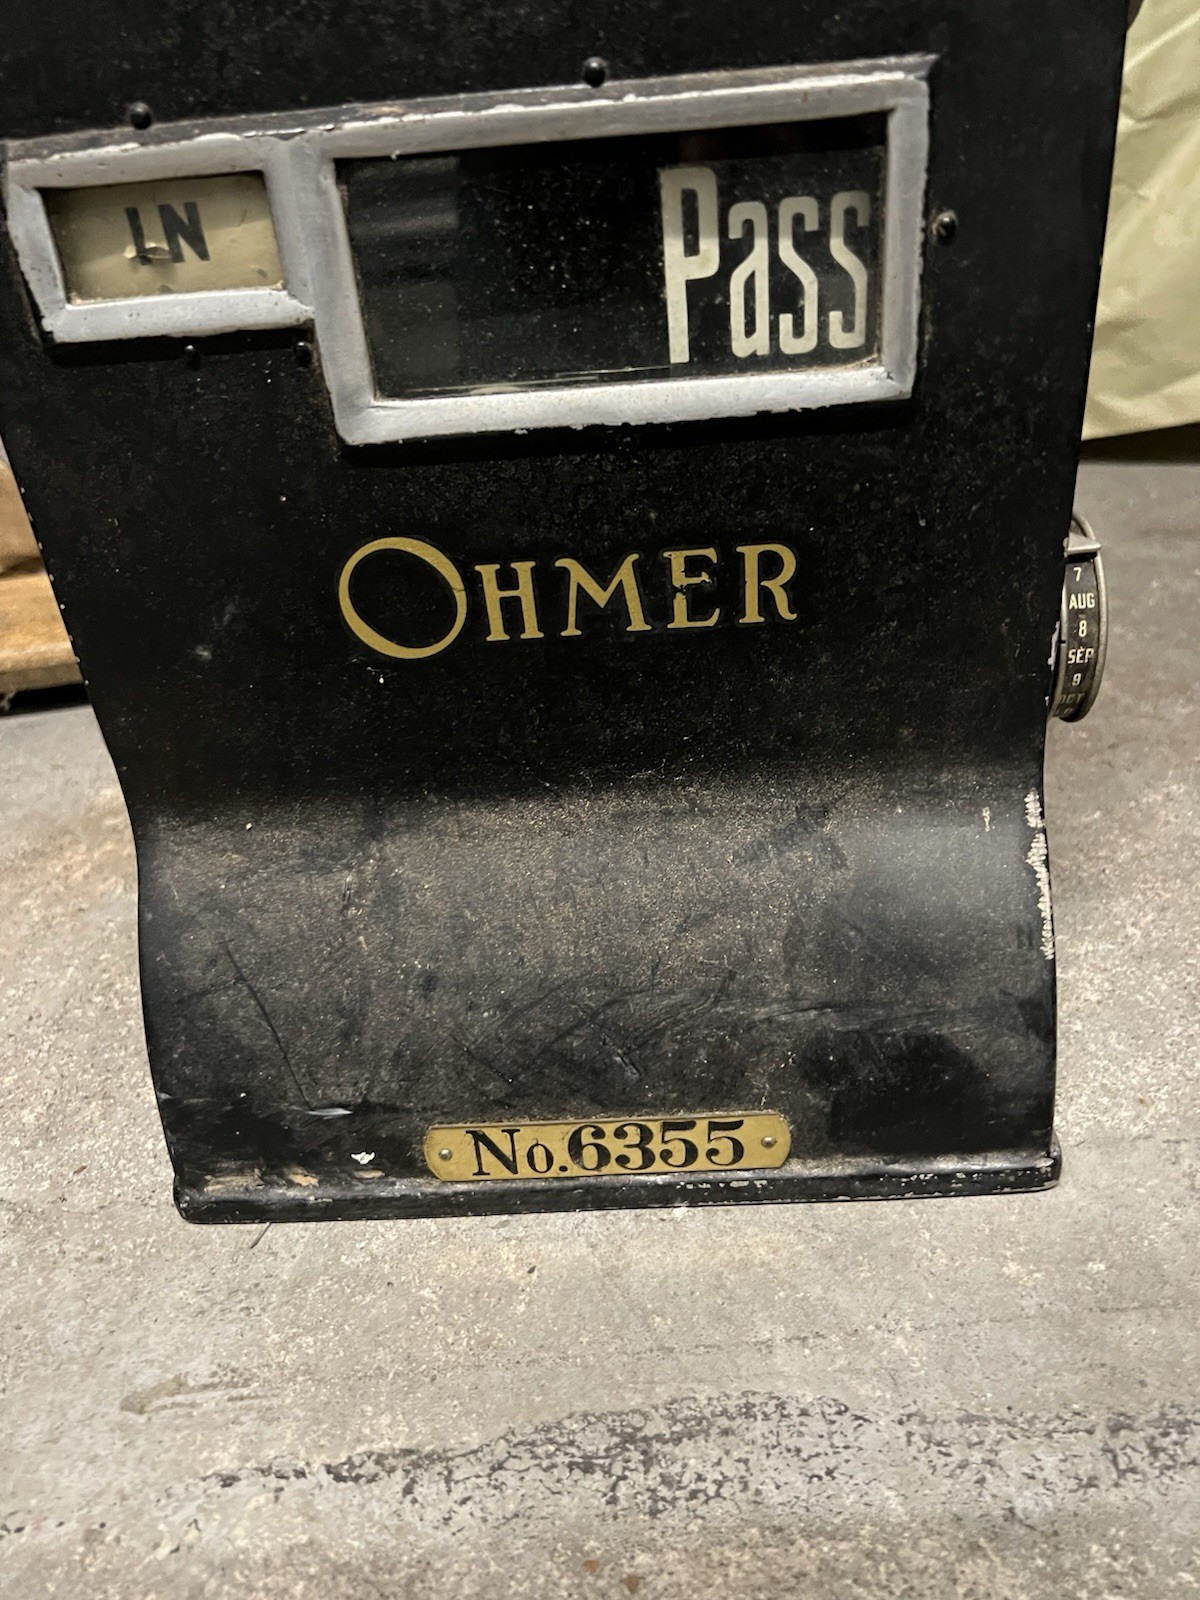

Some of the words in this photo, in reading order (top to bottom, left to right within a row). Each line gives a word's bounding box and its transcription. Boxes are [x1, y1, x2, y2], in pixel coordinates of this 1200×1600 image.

[126, 202, 210, 265] IN
[660, 166, 871, 363] Pass
[1073, 567, 1082, 582] 7
[338, 536, 798, 659] OHMER
[1069, 593, 1095, 609] AUG
[1078, 620, 1087, 637] 8
[1068, 648, 1094, 664] SEP
[1072, 673, 1081, 687] 9
